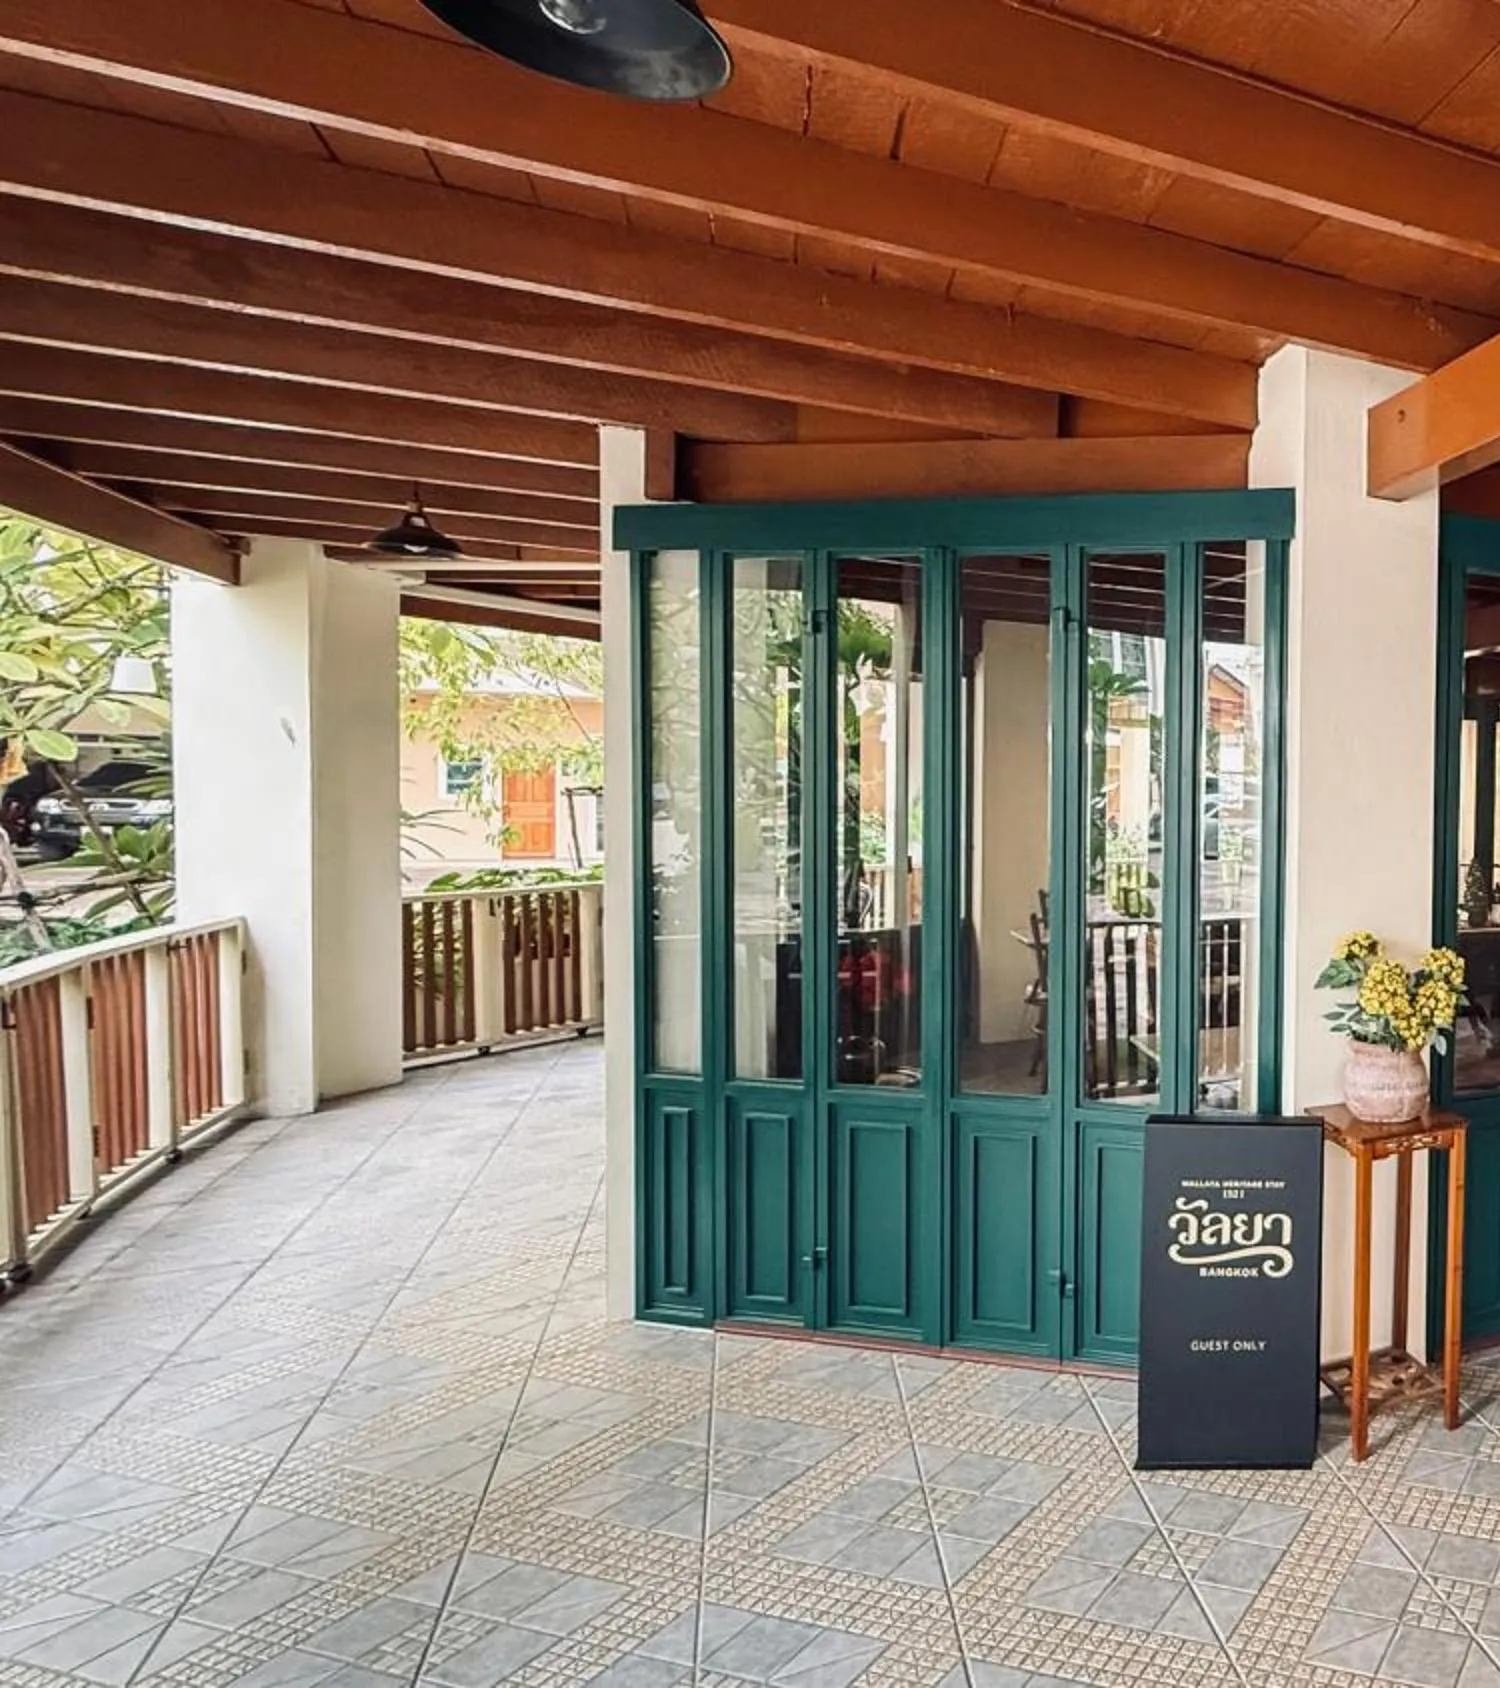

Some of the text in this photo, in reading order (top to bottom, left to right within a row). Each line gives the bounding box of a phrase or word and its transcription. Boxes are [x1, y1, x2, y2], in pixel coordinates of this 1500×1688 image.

[1168, 1197, 1292, 1246] วัลยา
[1199, 1267, 1259, 1277] BANGKOK
[1190, 1340, 1267, 1351] GUEST ONLY
